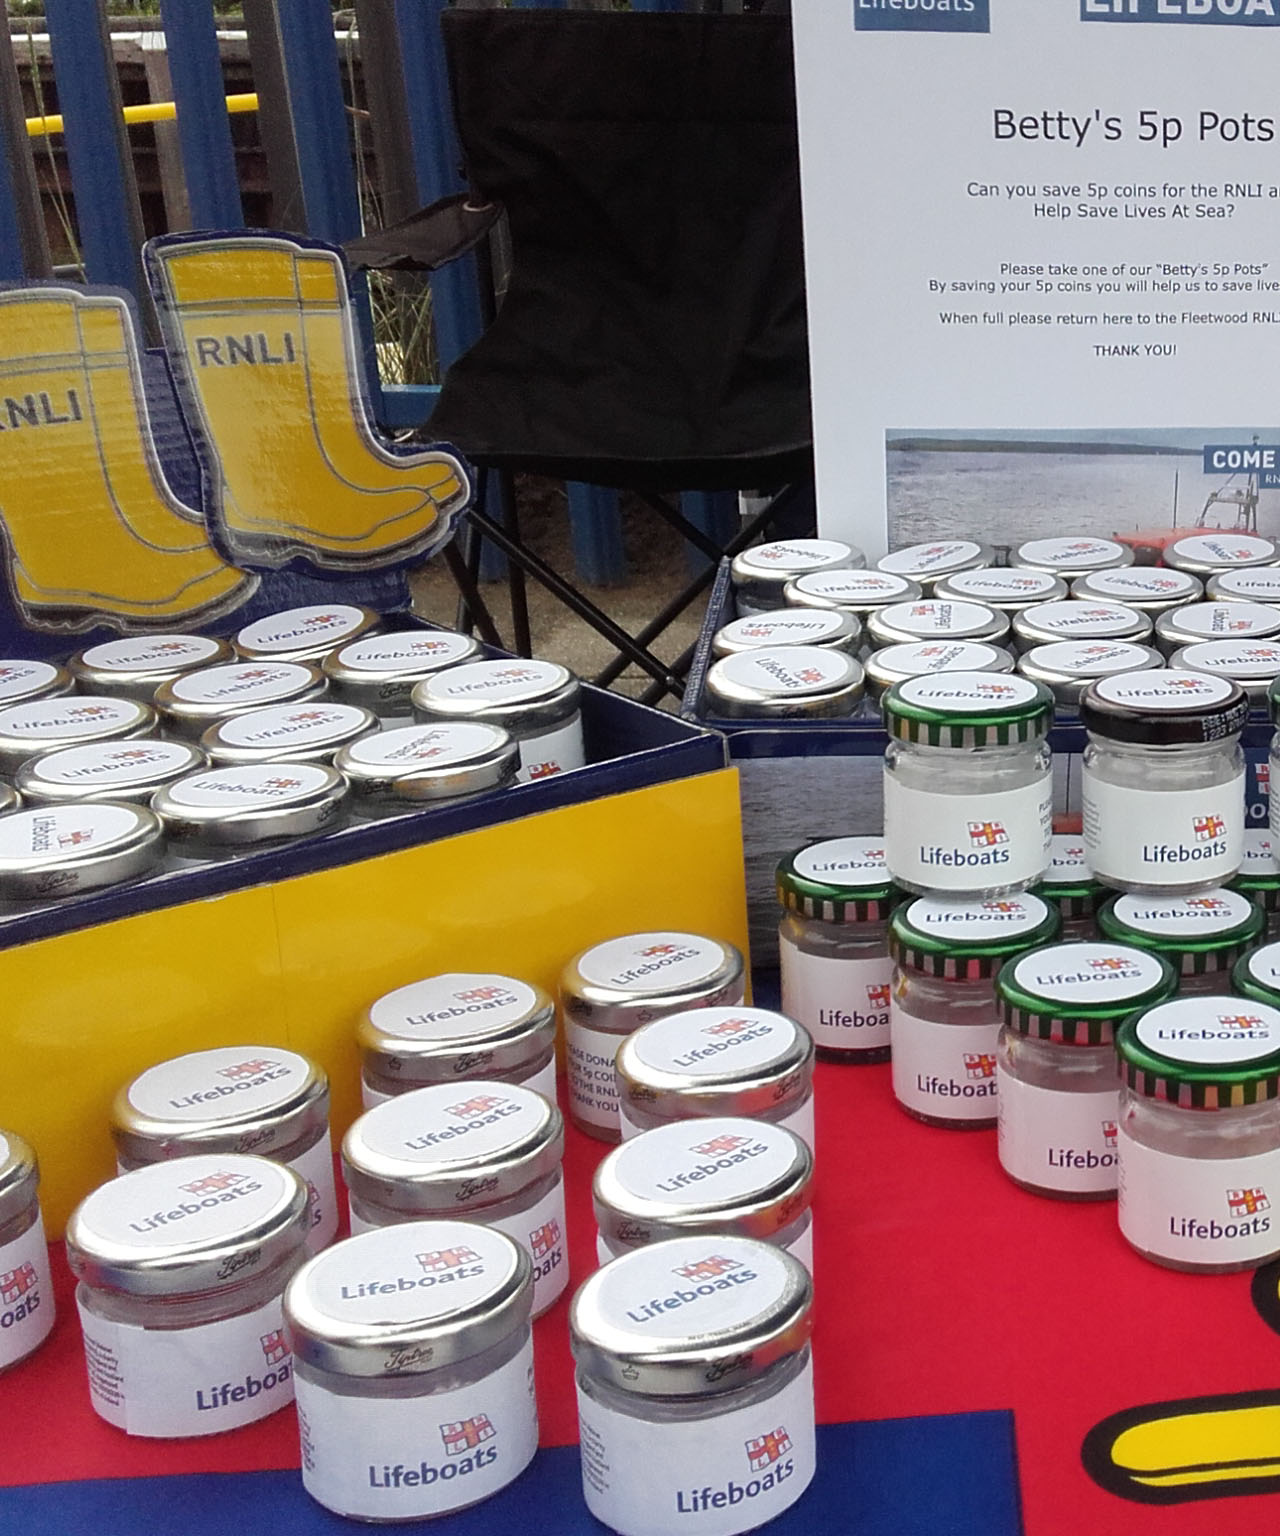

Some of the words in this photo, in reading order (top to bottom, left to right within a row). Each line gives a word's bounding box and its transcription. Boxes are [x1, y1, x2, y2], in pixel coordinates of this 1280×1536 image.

[994, 109, 1122, 148] Betty's
[1139, 111, 1182, 148] 5p
[1200, 111, 1274, 142] Pots
[967, 182, 999, 196] Can
[1006, 185, 1036, 200] you
[1043, 186, 1080, 197] save
[1088, 183, 1107, 200] 5p
[1114, 184, 1156, 197] coins
[1163, 183, 1185, 198] for
[1191, 183, 1217, 198] the
[1224, 184, 1262, 197] RNLI
[1035, 203, 1071, 220] Help
[1077, 203, 1118, 218] Save
[1125, 204, 1166, 218] Lives
[1172, 204, 1189, 218] At
[1196, 204, 1234, 218] Sea?
[1001, 263, 1044, 275] Please
[1048, 264, 1078, 275] take
[1082, 266, 1107, 275] one
[1112, 264, 1126, 276] of
[1130, 267, 1152, 275] our
[1213, 264, 1230, 277] 5p
[929, 280, 946, 294] By
[952, 280, 995, 293] saving
[1000, 282, 1031, 293] your
[1036, 280, 1053, 294] 5p
[1058, 281, 1091, 292] coins
[1096, 283, 1120, 294] you
[1126, 280, 1147, 292] will
[1153, 280, 1180, 294] help
[1185, 282, 1200, 291] us
[1205, 281, 1218, 291] to
[1222, 282, 1252, 291] save
[940, 312, 978, 324] When
[983, 312, 1003, 324] full
[1009, 312, 1051, 326] please
[1057, 313, 1097, 324] return
[1103, 313, 1132, 324] here
[1137, 314, 1150, 324] to
[1155, 312, 1176, 324] the
[1182, 312, 1247, 324] Fleetwood
[195, 333, 296, 367] RNLI
[1093, 345, 1139, 356] THANK
[1144, 344, 1176, 356] YOU!
[0, 389, 82, 429] NLI
[1213, 450, 1274, 468] COME
[257, 617, 348, 645] Lifeboats
[1048, 611, 1126, 629] Lifeboats
[355, 644, 451, 662] Lifeboats
[448, 673, 544, 696] Lifeboats
[917, 688, 1016, 700] Lifeboats
[1116, 687, 1215, 698] Lifeboats
[12, 710, 120, 731] Lifeboats
[245, 712, 345, 744] Lifeboats
[61, 751, 171, 779] Lifeboats
[193, 780, 288, 797] Lifeboats
[920, 846, 1010, 867] Lifeboats
[1143, 838, 1227, 864] Lifeboats
[926, 912, 1027, 923] Lifeboats
[1133, 906, 1232, 920] Lifeboats
[610, 948, 700, 986] Lifeboats
[1037, 968, 1142, 986] Lifeboats
[406, 994, 518, 1026] Lifeboats
[819, 1009, 889, 1028] Lifeboa
[672, 1023, 773, 1068] Lifeboats
[1157, 1028, 1270, 1041] Lifeboats
[169, 1065, 292, 1110] Lifeboats
[917, 1074, 997, 1098] Lifeboat
[405, 1101, 523, 1151] Lifeboats
[656, 1139, 769, 1194] Lifeboats
[1048, 1147, 1118, 1169] Lifebo
[130, 1181, 264, 1234] Lifeboats
[1169, 1216, 1271, 1240] Lifeboats
[341, 1263, 485, 1300] Lifeboats
[626, 1268, 758, 1323] Lifeboats
[196, 1355, 293, 1411] Lifeboa
[369, 1445, 497, 1488] Lifeboats
[677, 1458, 795, 1514] Lifeboats
